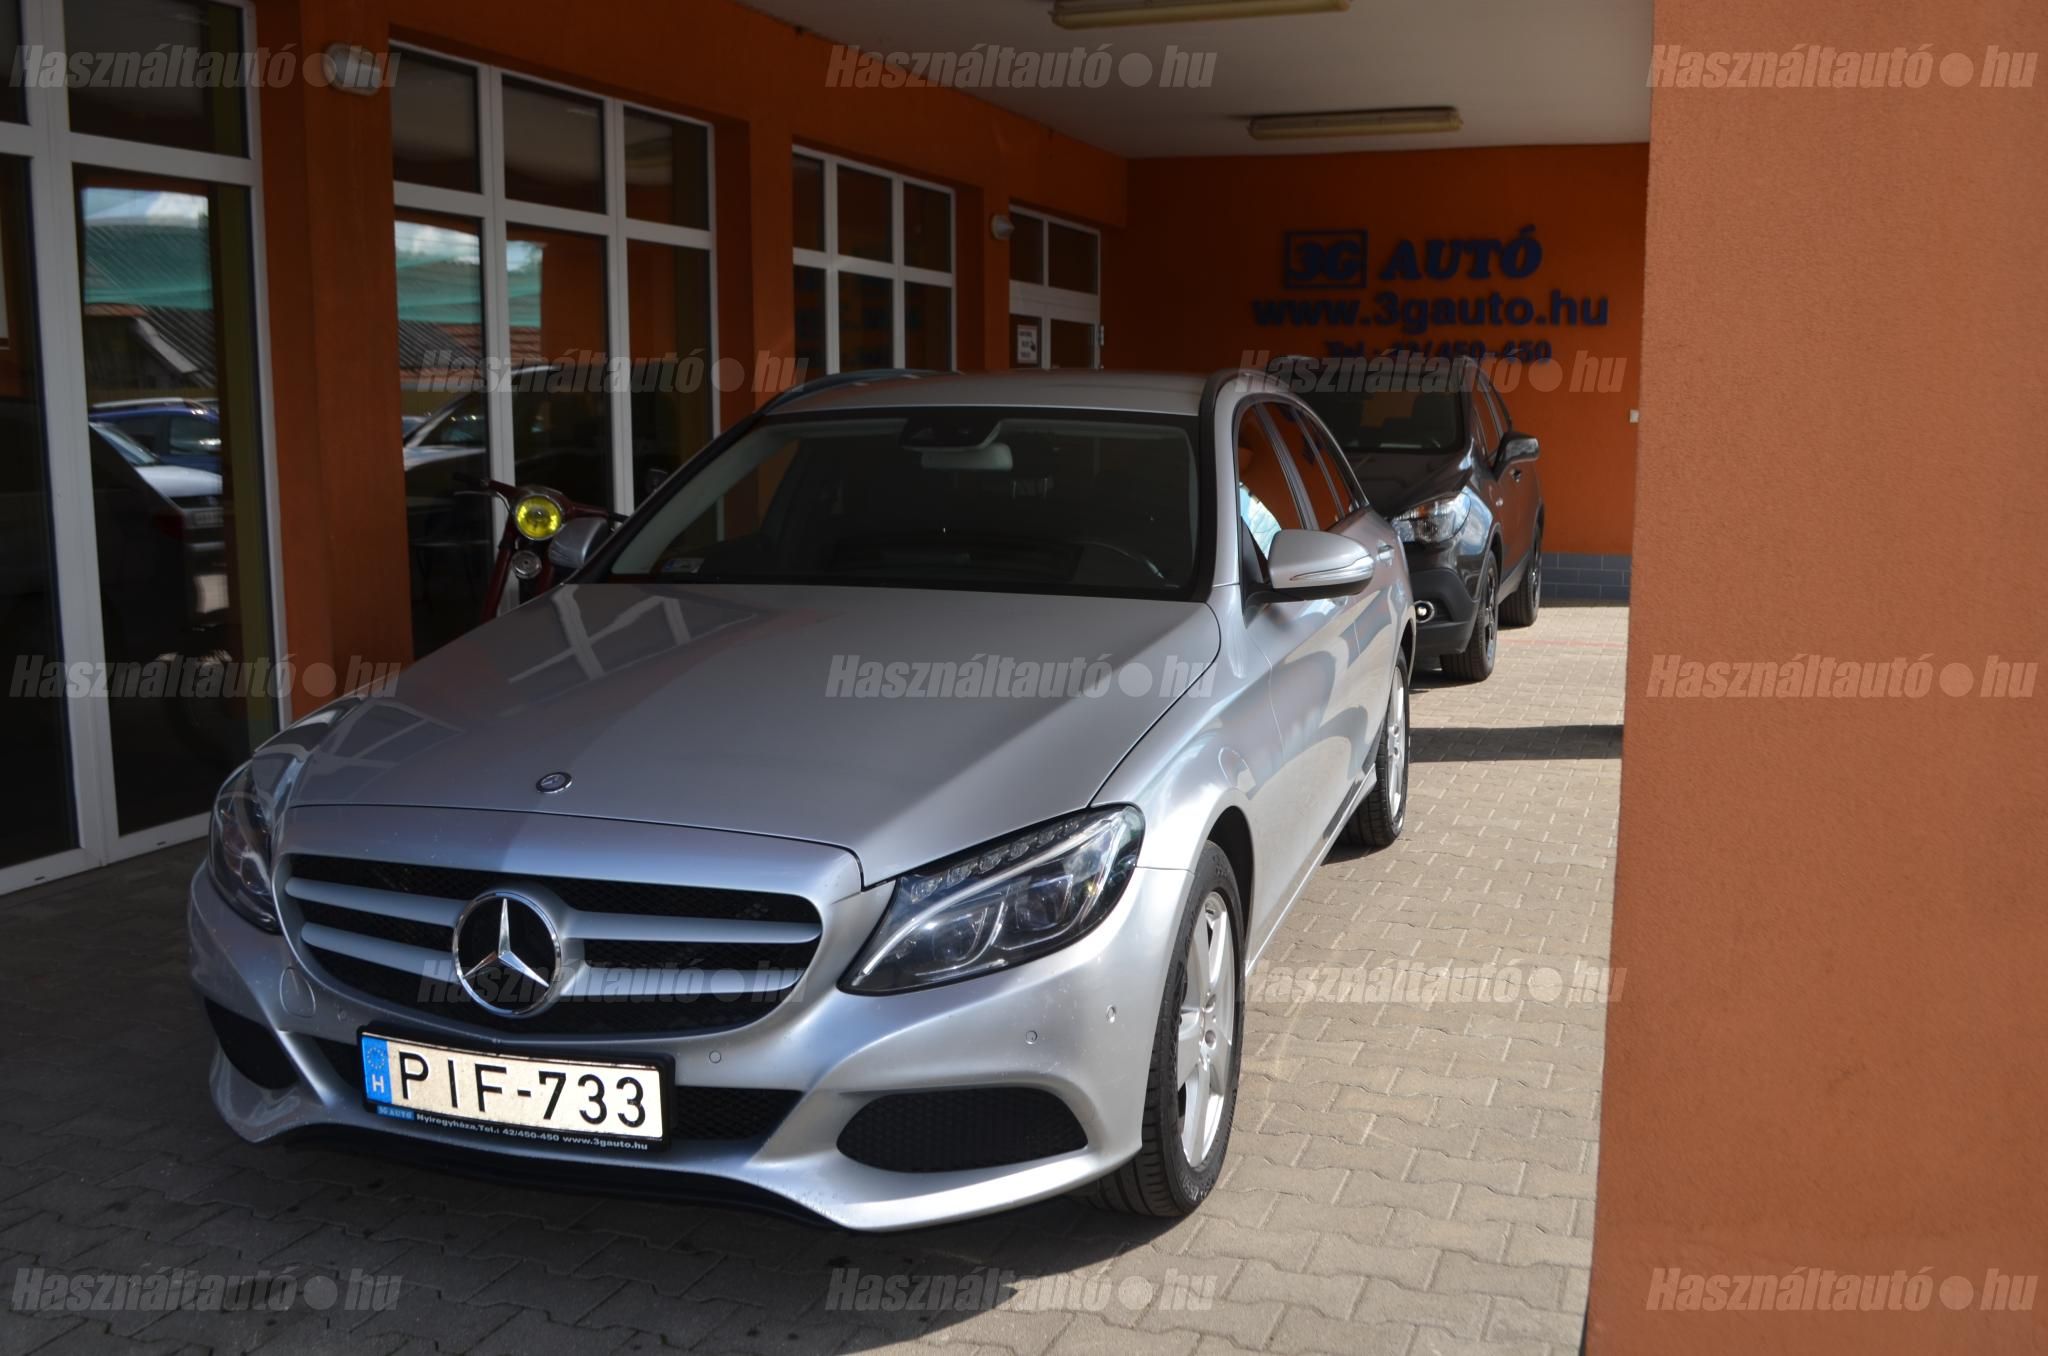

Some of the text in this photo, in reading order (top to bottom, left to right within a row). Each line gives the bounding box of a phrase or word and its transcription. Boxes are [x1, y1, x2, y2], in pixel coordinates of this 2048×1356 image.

[1286, 224, 1543, 281] 3G AUTÓ
[1252, 290, 1609, 334] www.3gauto.hu
[371, 1075, 385, 1094] H
[398, 1051, 646, 1128] PIF-733
[502, 1128, 560, 1142] 42/450-450
[562, 1136, 649, 1151] www.3gauto.hu
